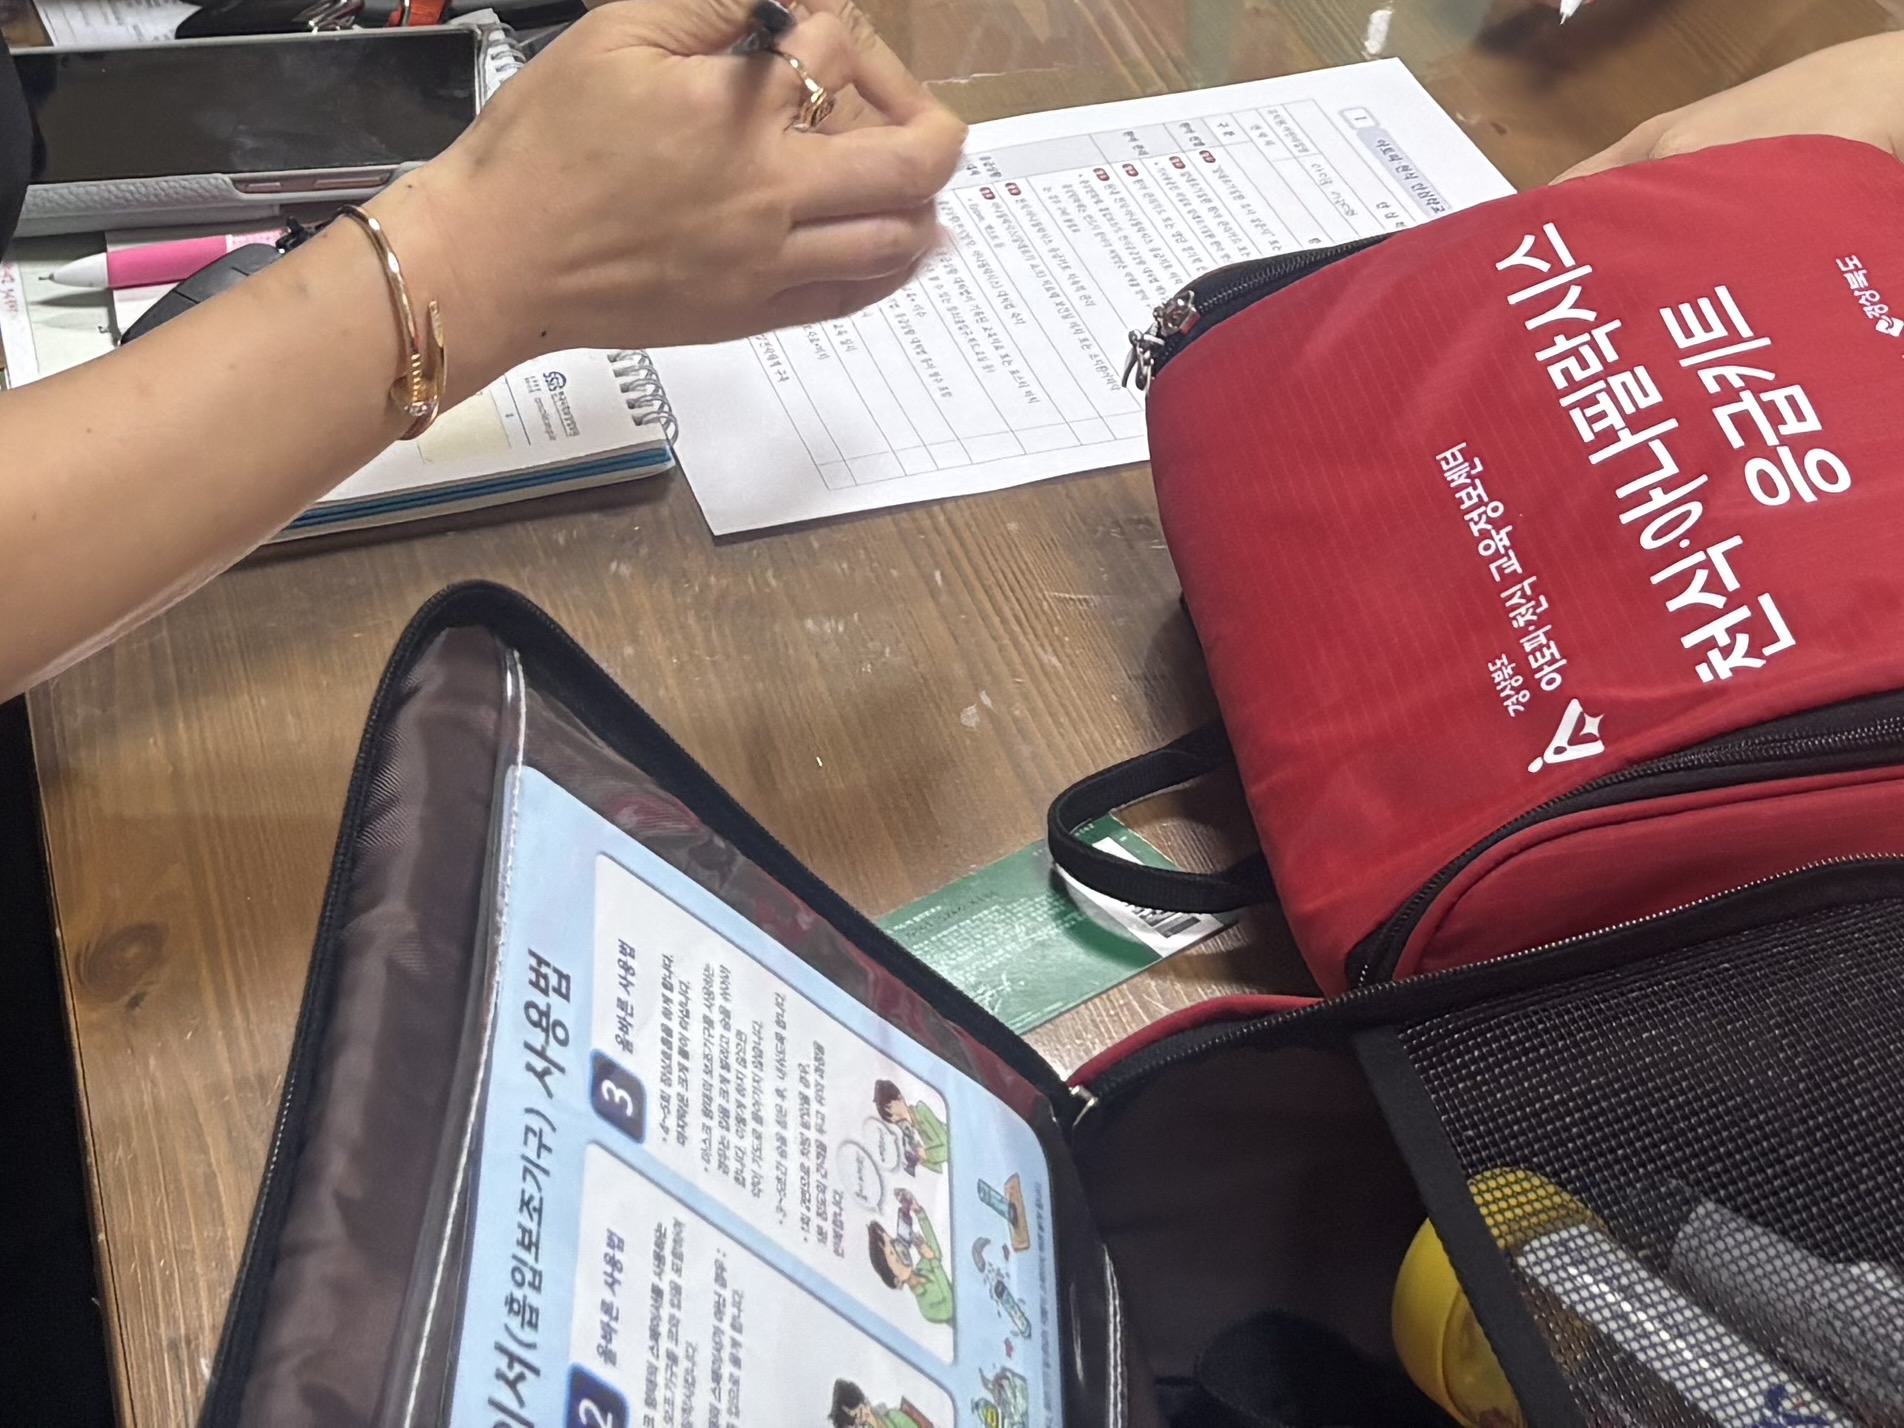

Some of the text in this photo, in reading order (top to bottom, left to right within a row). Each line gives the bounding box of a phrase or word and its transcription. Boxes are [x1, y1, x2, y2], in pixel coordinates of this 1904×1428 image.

[1836, 253, 1888, 322] 경상북도
[1497, 222, 1797, 682] 천식·아나필락시스
[1667, 285, 1851, 506] 응급키트
[1436, 442, 1567, 691] 아토피·천식 교육정보센터
[1489, 654, 1530, 717] 경상북도
[523, 949, 571, 1101] 사용법
[614, 939, 638, 1055] 올바른 사용법
[599, 1079, 637, 1118] 3
[595, 1229, 625, 1368] 올바른 사용법
